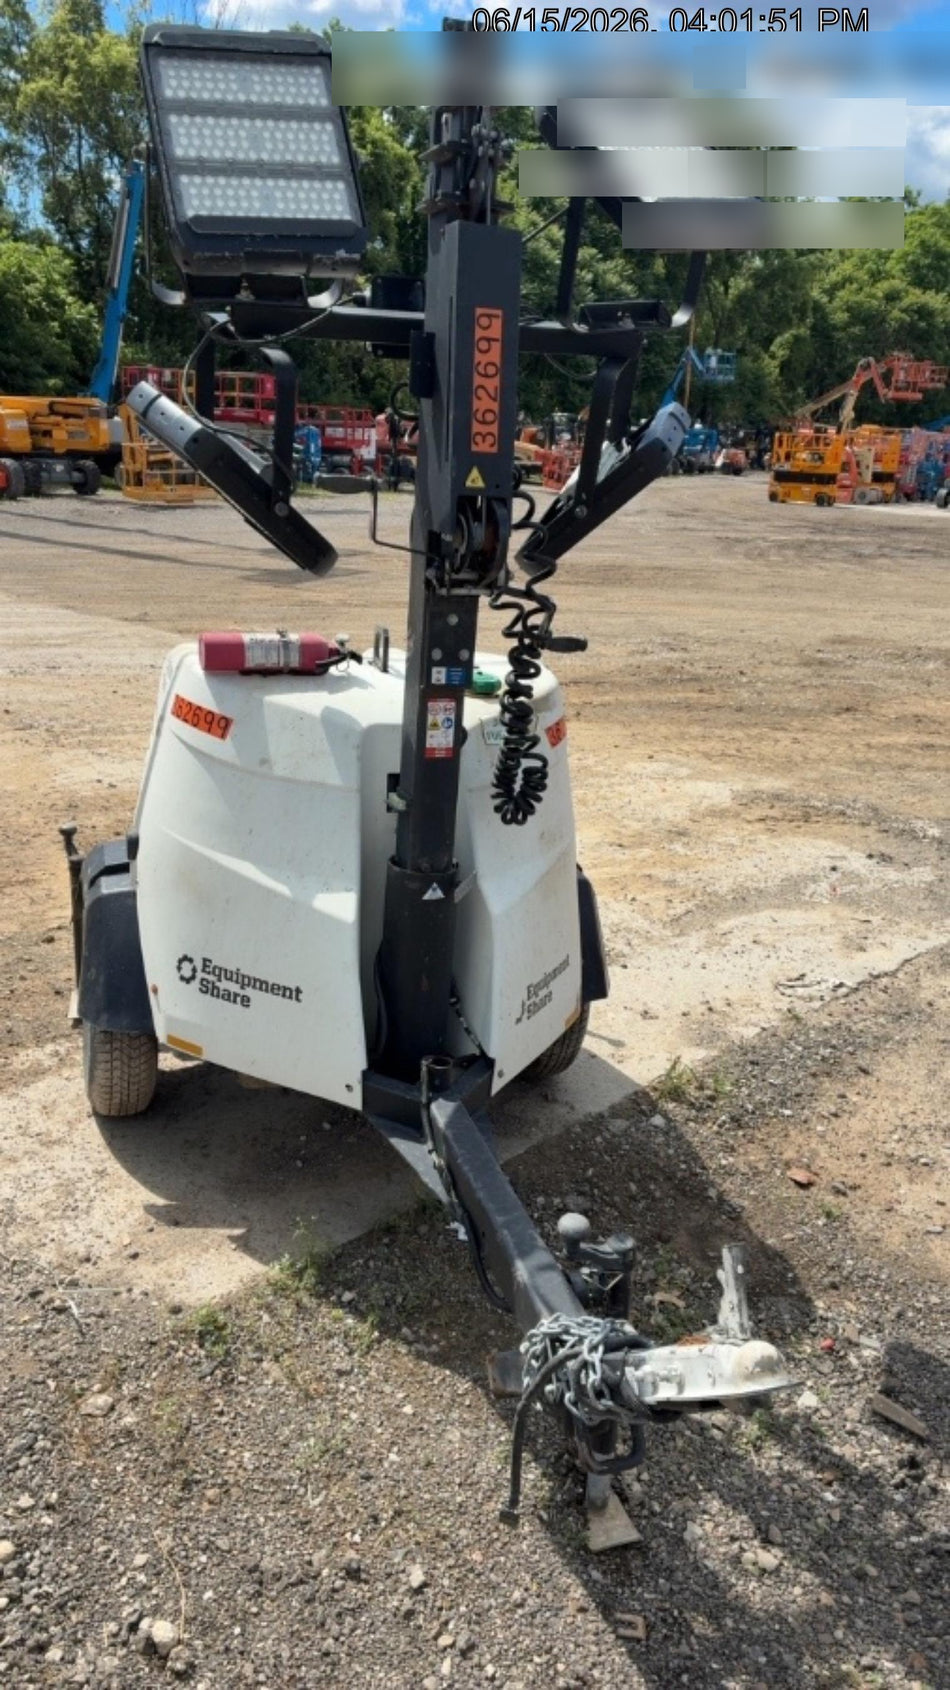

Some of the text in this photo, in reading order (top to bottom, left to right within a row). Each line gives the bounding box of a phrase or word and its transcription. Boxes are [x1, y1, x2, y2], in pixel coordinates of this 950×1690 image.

[473, 312, 500, 448] 362699
[172, 695, 230, 740] 62699
[199, 978, 251, 1008] Share
[201, 957, 303, 1003] Equipment
